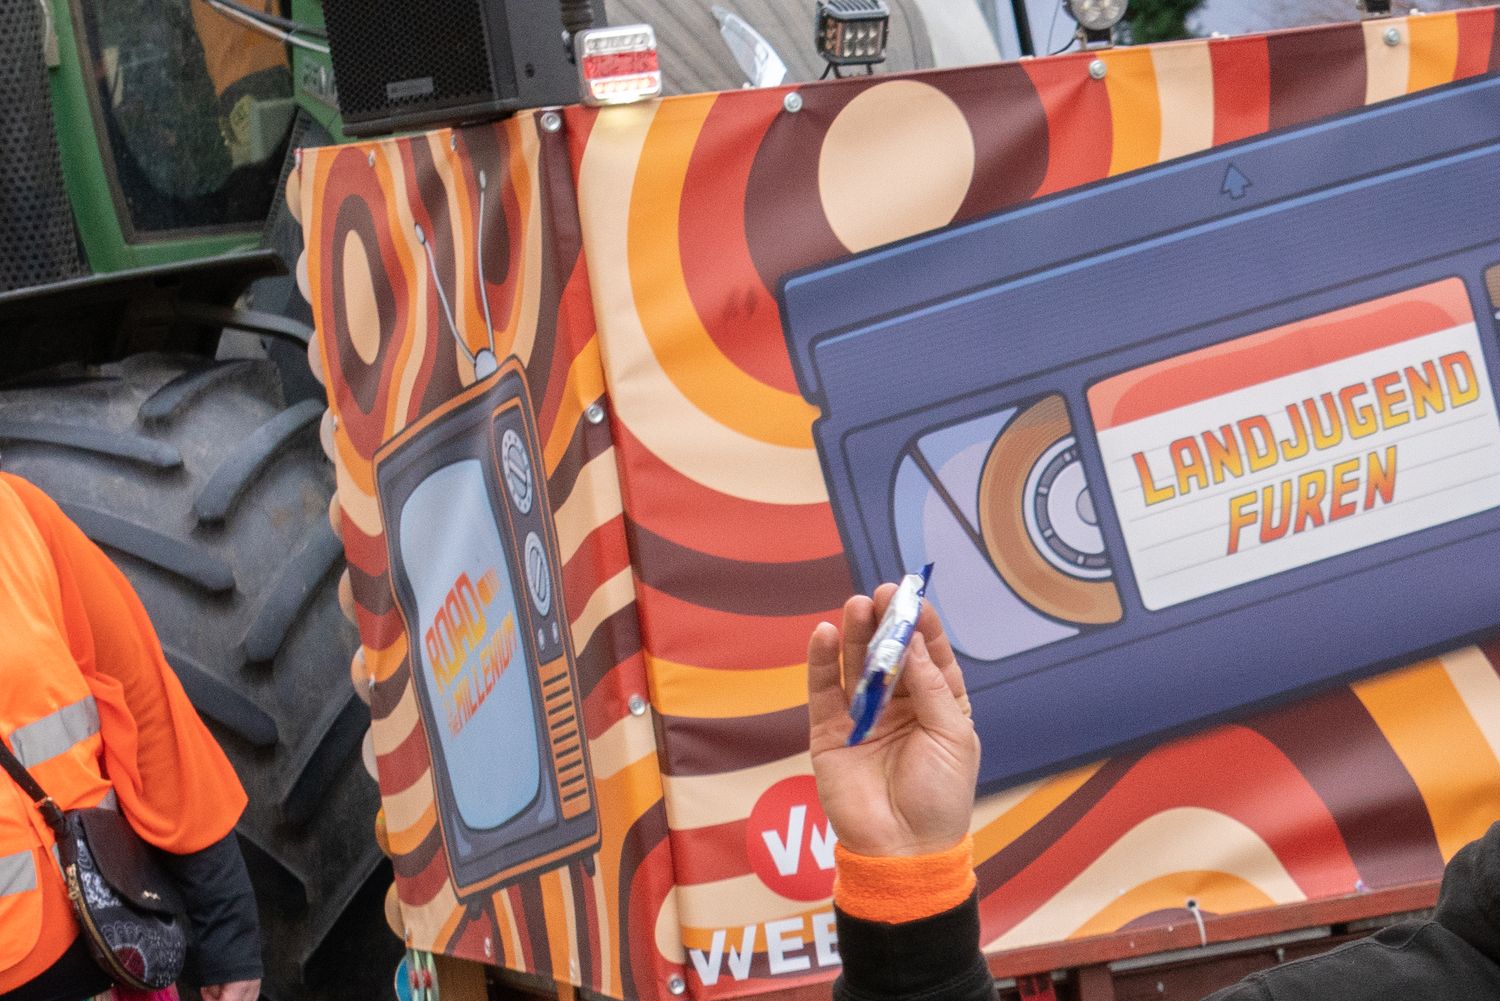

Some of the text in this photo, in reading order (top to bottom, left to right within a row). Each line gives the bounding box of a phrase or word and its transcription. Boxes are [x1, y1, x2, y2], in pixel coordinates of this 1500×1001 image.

[1132, 350, 1480, 507] LANDJUGEND
[1226, 444, 1398, 556] FUREN
[424, 571, 487, 695] ROAD
[689, 911, 843, 987] WEB
